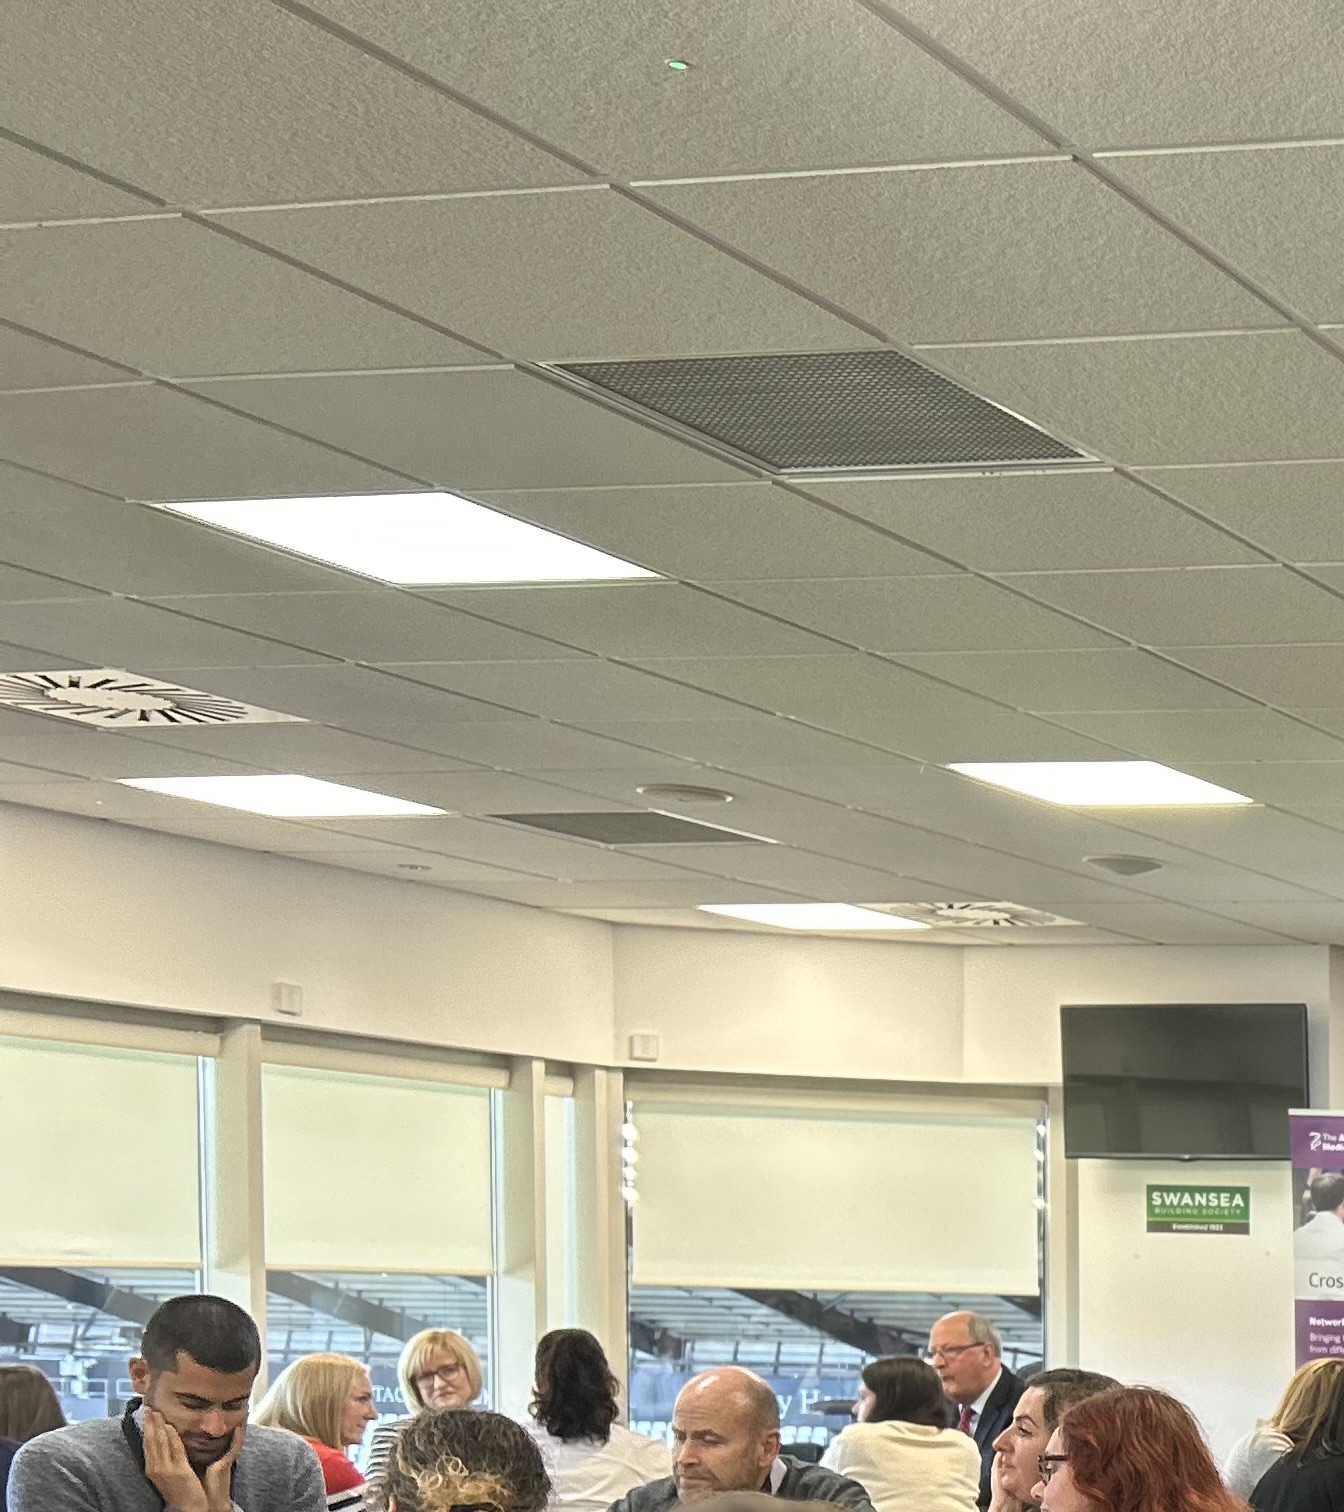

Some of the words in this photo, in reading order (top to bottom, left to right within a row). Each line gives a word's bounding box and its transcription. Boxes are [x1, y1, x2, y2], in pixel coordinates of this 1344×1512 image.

[1151, 1190, 1245, 1208] SWANSEA
[1153, 1206, 1199, 1215] BUILDING
[1202, 1207, 1242, 1216] SOCIETY
[1309, 1331, 1342, 1345] Bringing
[1309, 1345, 1328, 1355] from
